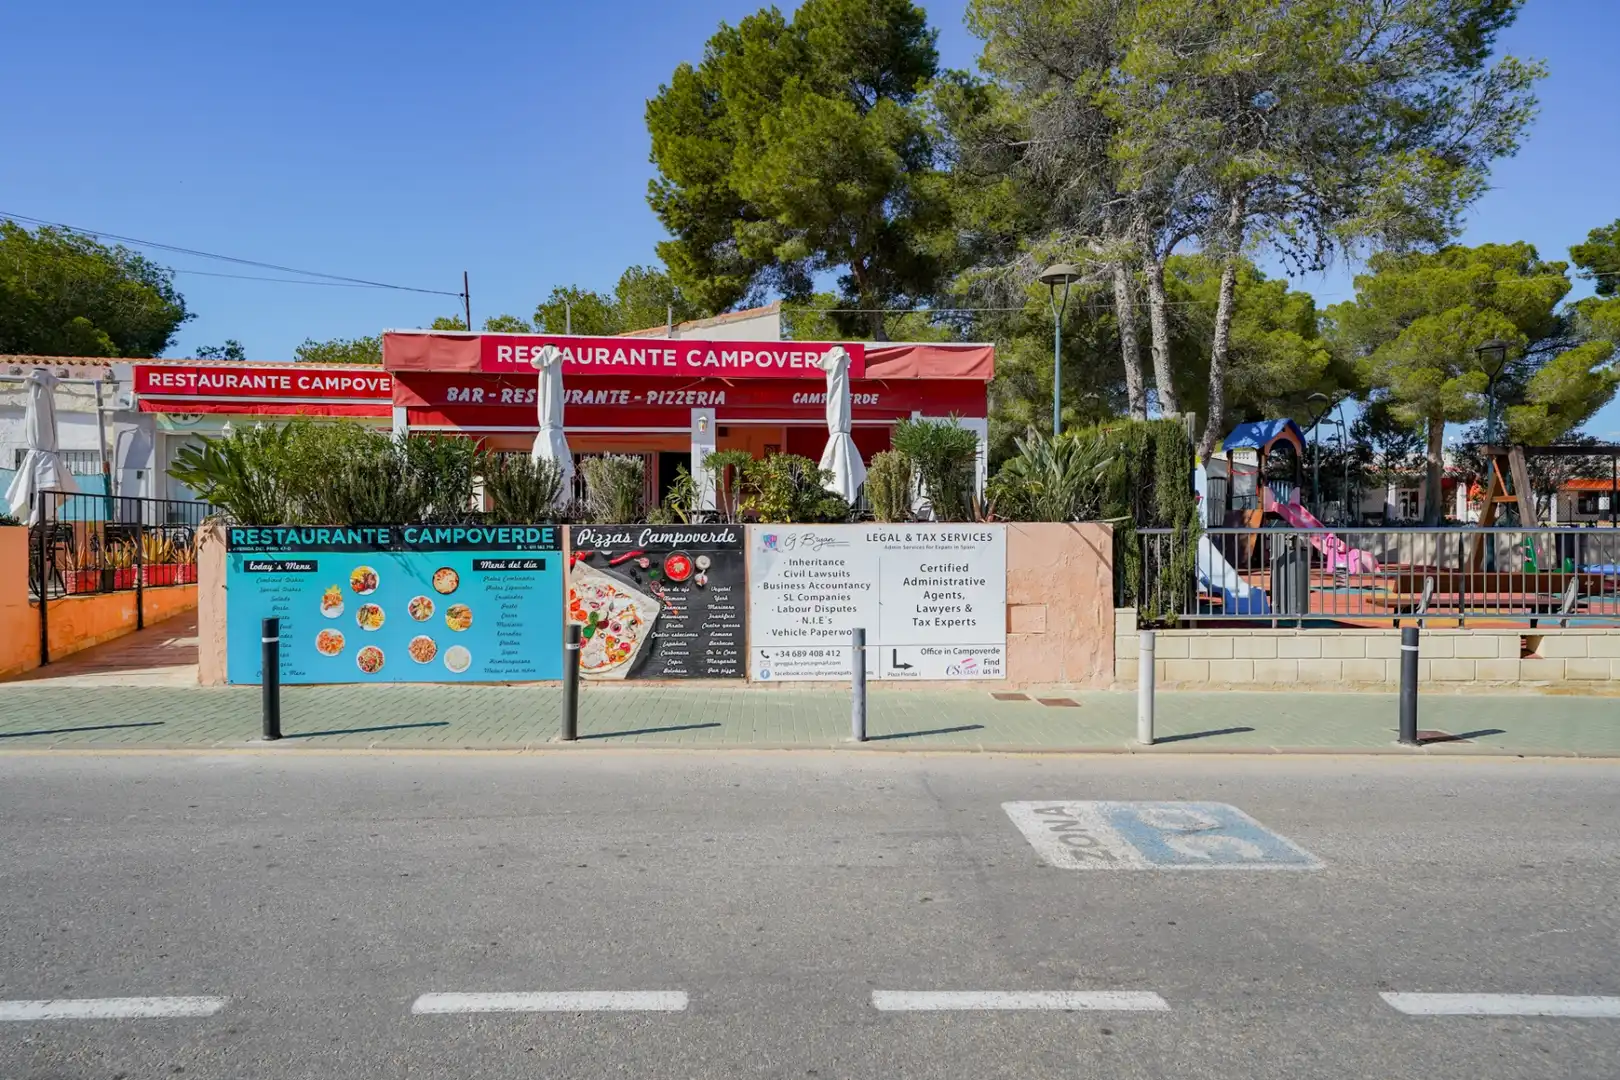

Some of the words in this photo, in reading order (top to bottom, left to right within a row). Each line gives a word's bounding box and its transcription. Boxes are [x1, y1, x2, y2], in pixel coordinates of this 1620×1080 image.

[497, 345, 677, 366] RESAURANTE
[686, 350, 852, 369] CAMPOVER
[149, 372, 291, 389] RESTAURANTE
[298, 375, 390, 391] CAMPOVE
[447, 387, 483, 403] BAR
[500, 388, 629, 405] RESURANTE
[646, 390, 726, 405] PIZZERIA
[792, 392, 879, 404] CAMPRDE
[232, 528, 390, 545] RESTAURANTE
[404, 528, 554, 544] CAMPOVERDE
[577, 528, 633, 547] Pizzas
[638, 527, 737, 547] Campoverde
[866, 533, 901, 542] LEGAL
[905, 533, 913, 542] &
[916, 533, 937, 542] TAX
[941, 532, 993, 542] SERVICES
[285, 561, 312, 570] Menu
[480, 559, 506, 569] Menú
[508, 560, 521, 569] del
[523, 559, 538, 569] día
[789, 558, 845, 567] Inheritance
[920, 563, 969, 573] Certified
[783, 569, 805, 578] Civil
[808, 570, 851, 578] Lawsuits
[763, 582, 806, 590] Business
[808, 582, 871, 591] Accountancy
[903, 577, 986, 586] Administrative
[783, 593, 794, 601] SL
[798, 593, 851, 602] Companies
[923, 590, 966, 602] Agents,
[777, 605, 811, 613] Labour
[814, 604, 857, 614] Disputes
[916, 604, 961, 614] Lawyers
[964, 603, 973, 613] &
[912, 617, 931, 626] Tax
[935, 617, 977, 628] Experts
[771, 628, 807, 637] Vehicle
[810, 628, 852, 637] Paperwo
[775, 650, 790, 658] +34
[791, 650, 807, 658] 689
[826, 649, 841, 657] 412
[920, 647, 943, 655] Office
[944, 647, 952, 655] in
[953, 647, 1000, 656] Campoverde
[983, 658, 1000, 666] Find
